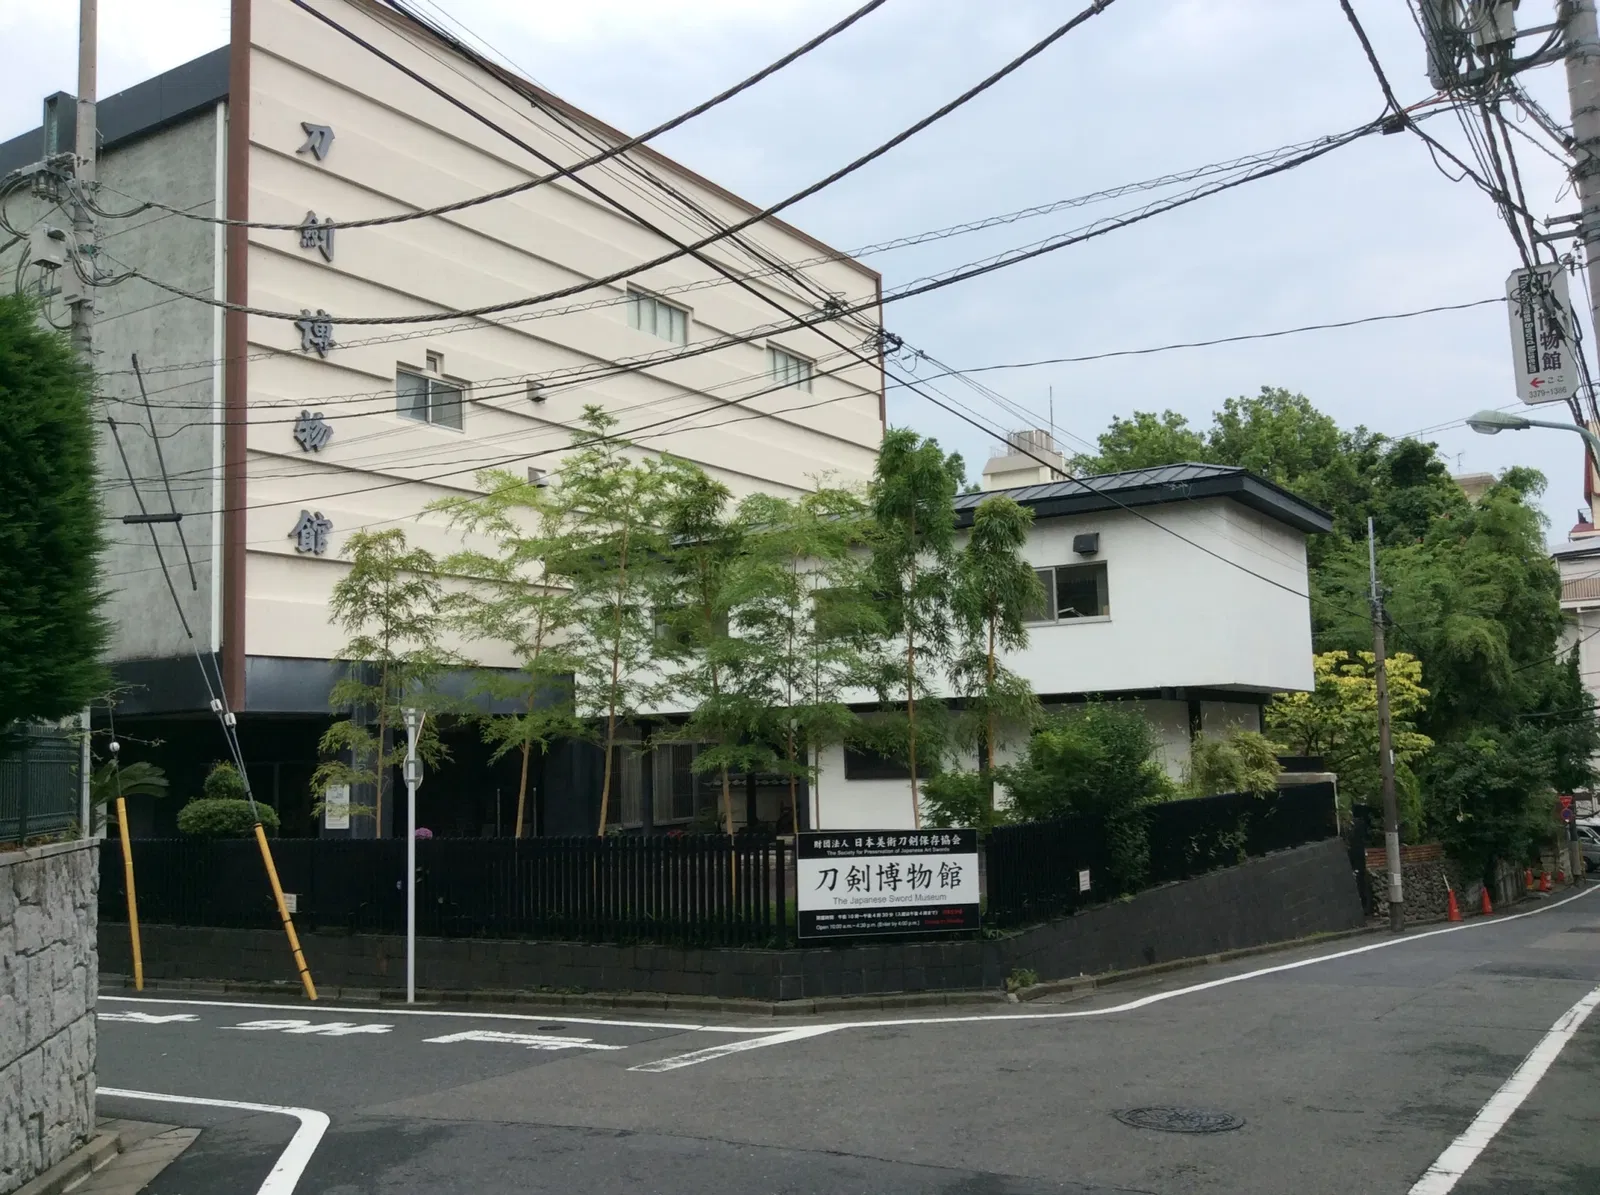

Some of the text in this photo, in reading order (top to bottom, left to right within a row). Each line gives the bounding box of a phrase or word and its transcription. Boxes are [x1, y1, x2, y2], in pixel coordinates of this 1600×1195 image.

[1524, 322, 1535, 346] Sword
[1527, 345, 1537, 373] Museum
[813, 838, 850, 849] 財団法人
[814, 862, 963, 893] 刀剣博物館
[833, 893, 948, 905] The Japanese Sword Museum
